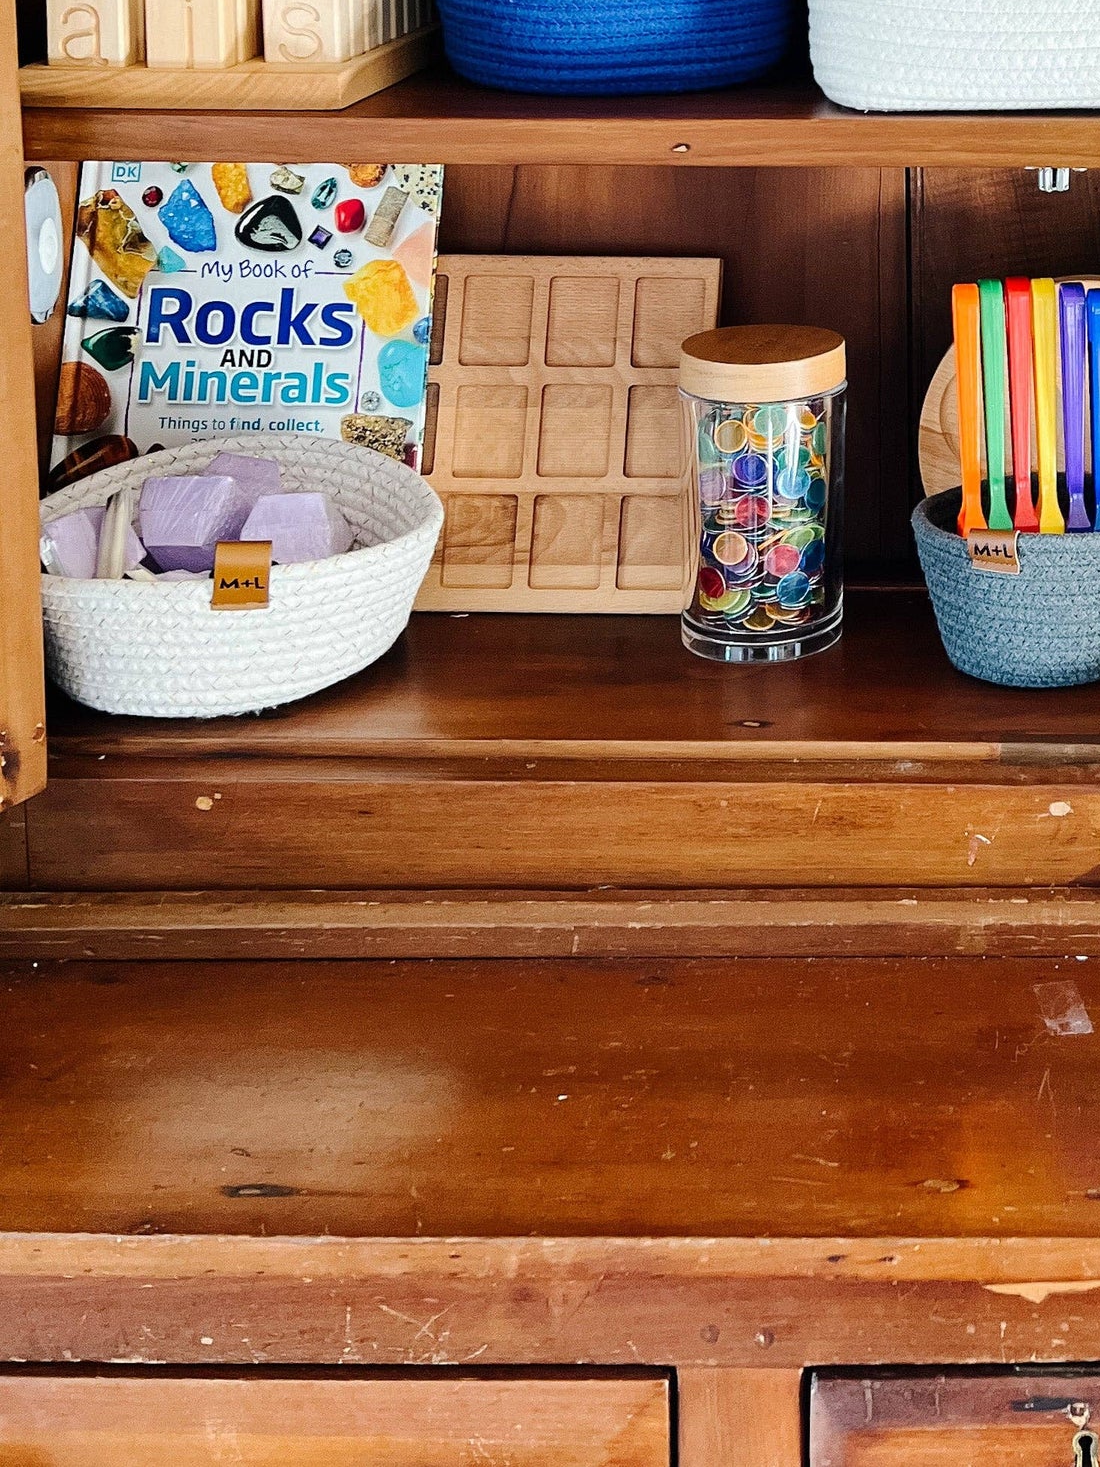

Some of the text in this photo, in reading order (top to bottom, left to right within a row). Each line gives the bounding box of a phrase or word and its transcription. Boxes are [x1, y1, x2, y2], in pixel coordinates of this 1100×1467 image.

[60, 2, 109, 66] a
[278, 2, 323, 63] s
[115, 166, 138, 178] DK
[201, 259, 316, 282] My Book of
[145, 287, 356, 347] Rocks
[219, 349, 273, 368] AND
[137, 360, 350, 404] Minerals
[158, 416, 208, 431] Things
[212, 419, 226, 431] to
[268, 419, 325, 433] collect,
[974, 542, 1013, 559] M+L
[220, 576, 265, 590] M+L
